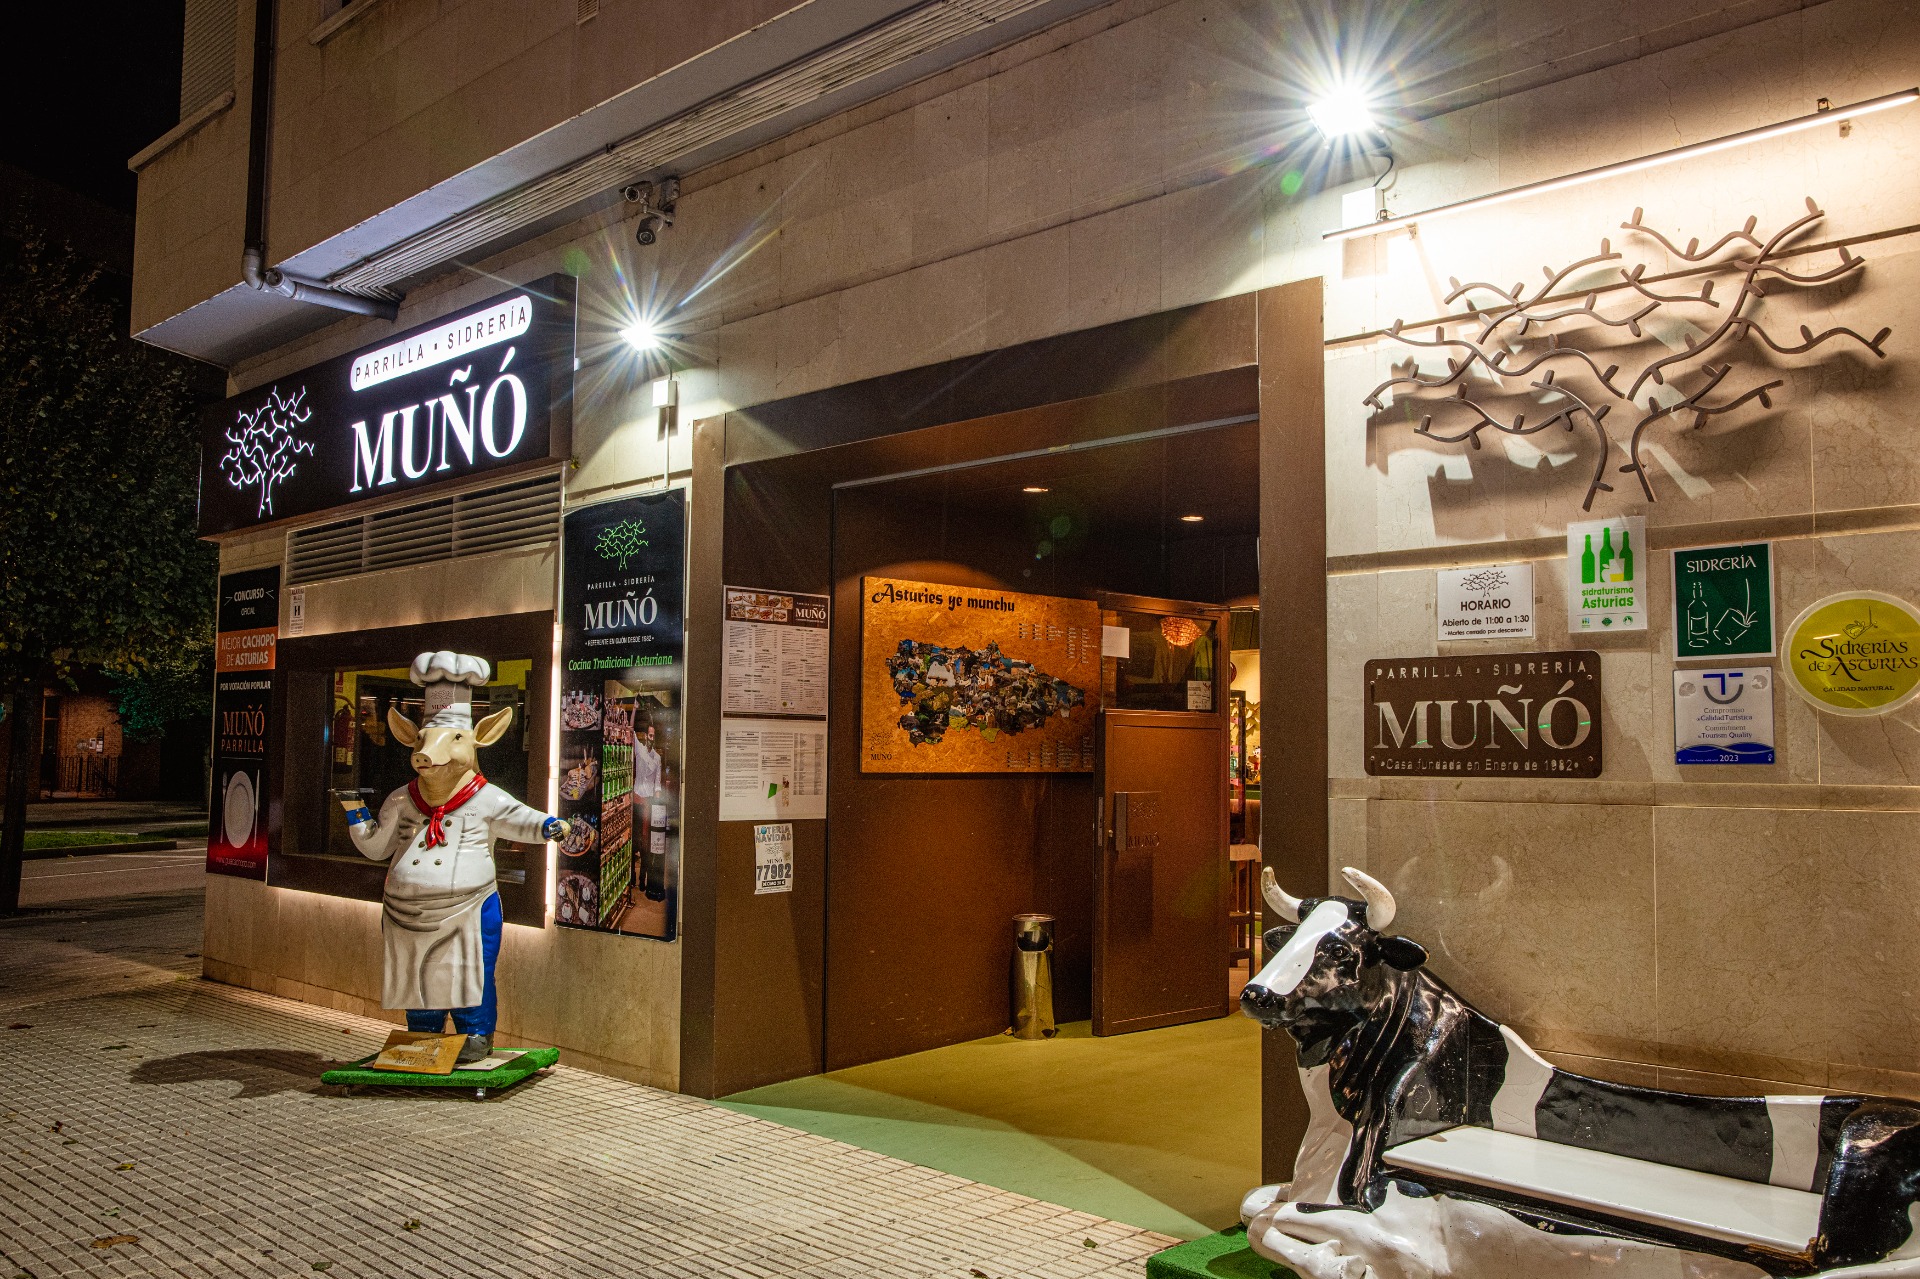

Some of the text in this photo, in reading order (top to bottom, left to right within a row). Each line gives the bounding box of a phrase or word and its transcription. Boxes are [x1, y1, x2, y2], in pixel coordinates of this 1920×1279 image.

[355, 305, 527, 383] PARRILLA SIDRERÍA
[350, 346, 528, 493] MUÑÓ
[1686, 554, 1757, 573] SIDRERÍA
[587, 575, 655, 591] PARRILLA SIDRERÍA
[234, 588, 265, 602] CONCURSO
[871, 583, 1015, 612] Asturies ye munchu
[1581, 587, 1634, 597] sidraturismo
[583, 588, 658, 630] MUÑÓ
[1460, 598, 1511, 611] HORARIO
[1582, 596, 1634, 609] Asturias
[795, 607, 827, 620] MUÑÓ
[1485, 616, 1504, 624] 11:00
[1514, 615, 1530, 623] 1:30
[221, 633, 275, 651] MEJOR CACHOPO
[226, 650, 269, 666] DE ASTURIAS
[568, 653, 673, 671] Cocina Tradicional Asturiana
[1376, 660, 1587, 679] PARRILLA SIDRERÍA
[220, 680, 271, 691] POR VOTACIÓN POPULAR
[223, 704, 265, 737] MUÑÓ
[1373, 679, 1592, 750] MUÑÓ
[221, 738, 264, 753] PARRILLA
[1386, 758, 1413, 770] Casa
[1416, 758, 1462, 770] fundada
[1466, 760, 1480, 771] en
[1485, 758, 1519, 771] Enero
[1524, 759, 1538, 770] de
[1719, 754, 1739, 762] 2023
[755, 833, 792, 843] NAVIDAD
[757, 863, 791, 880] 77982
